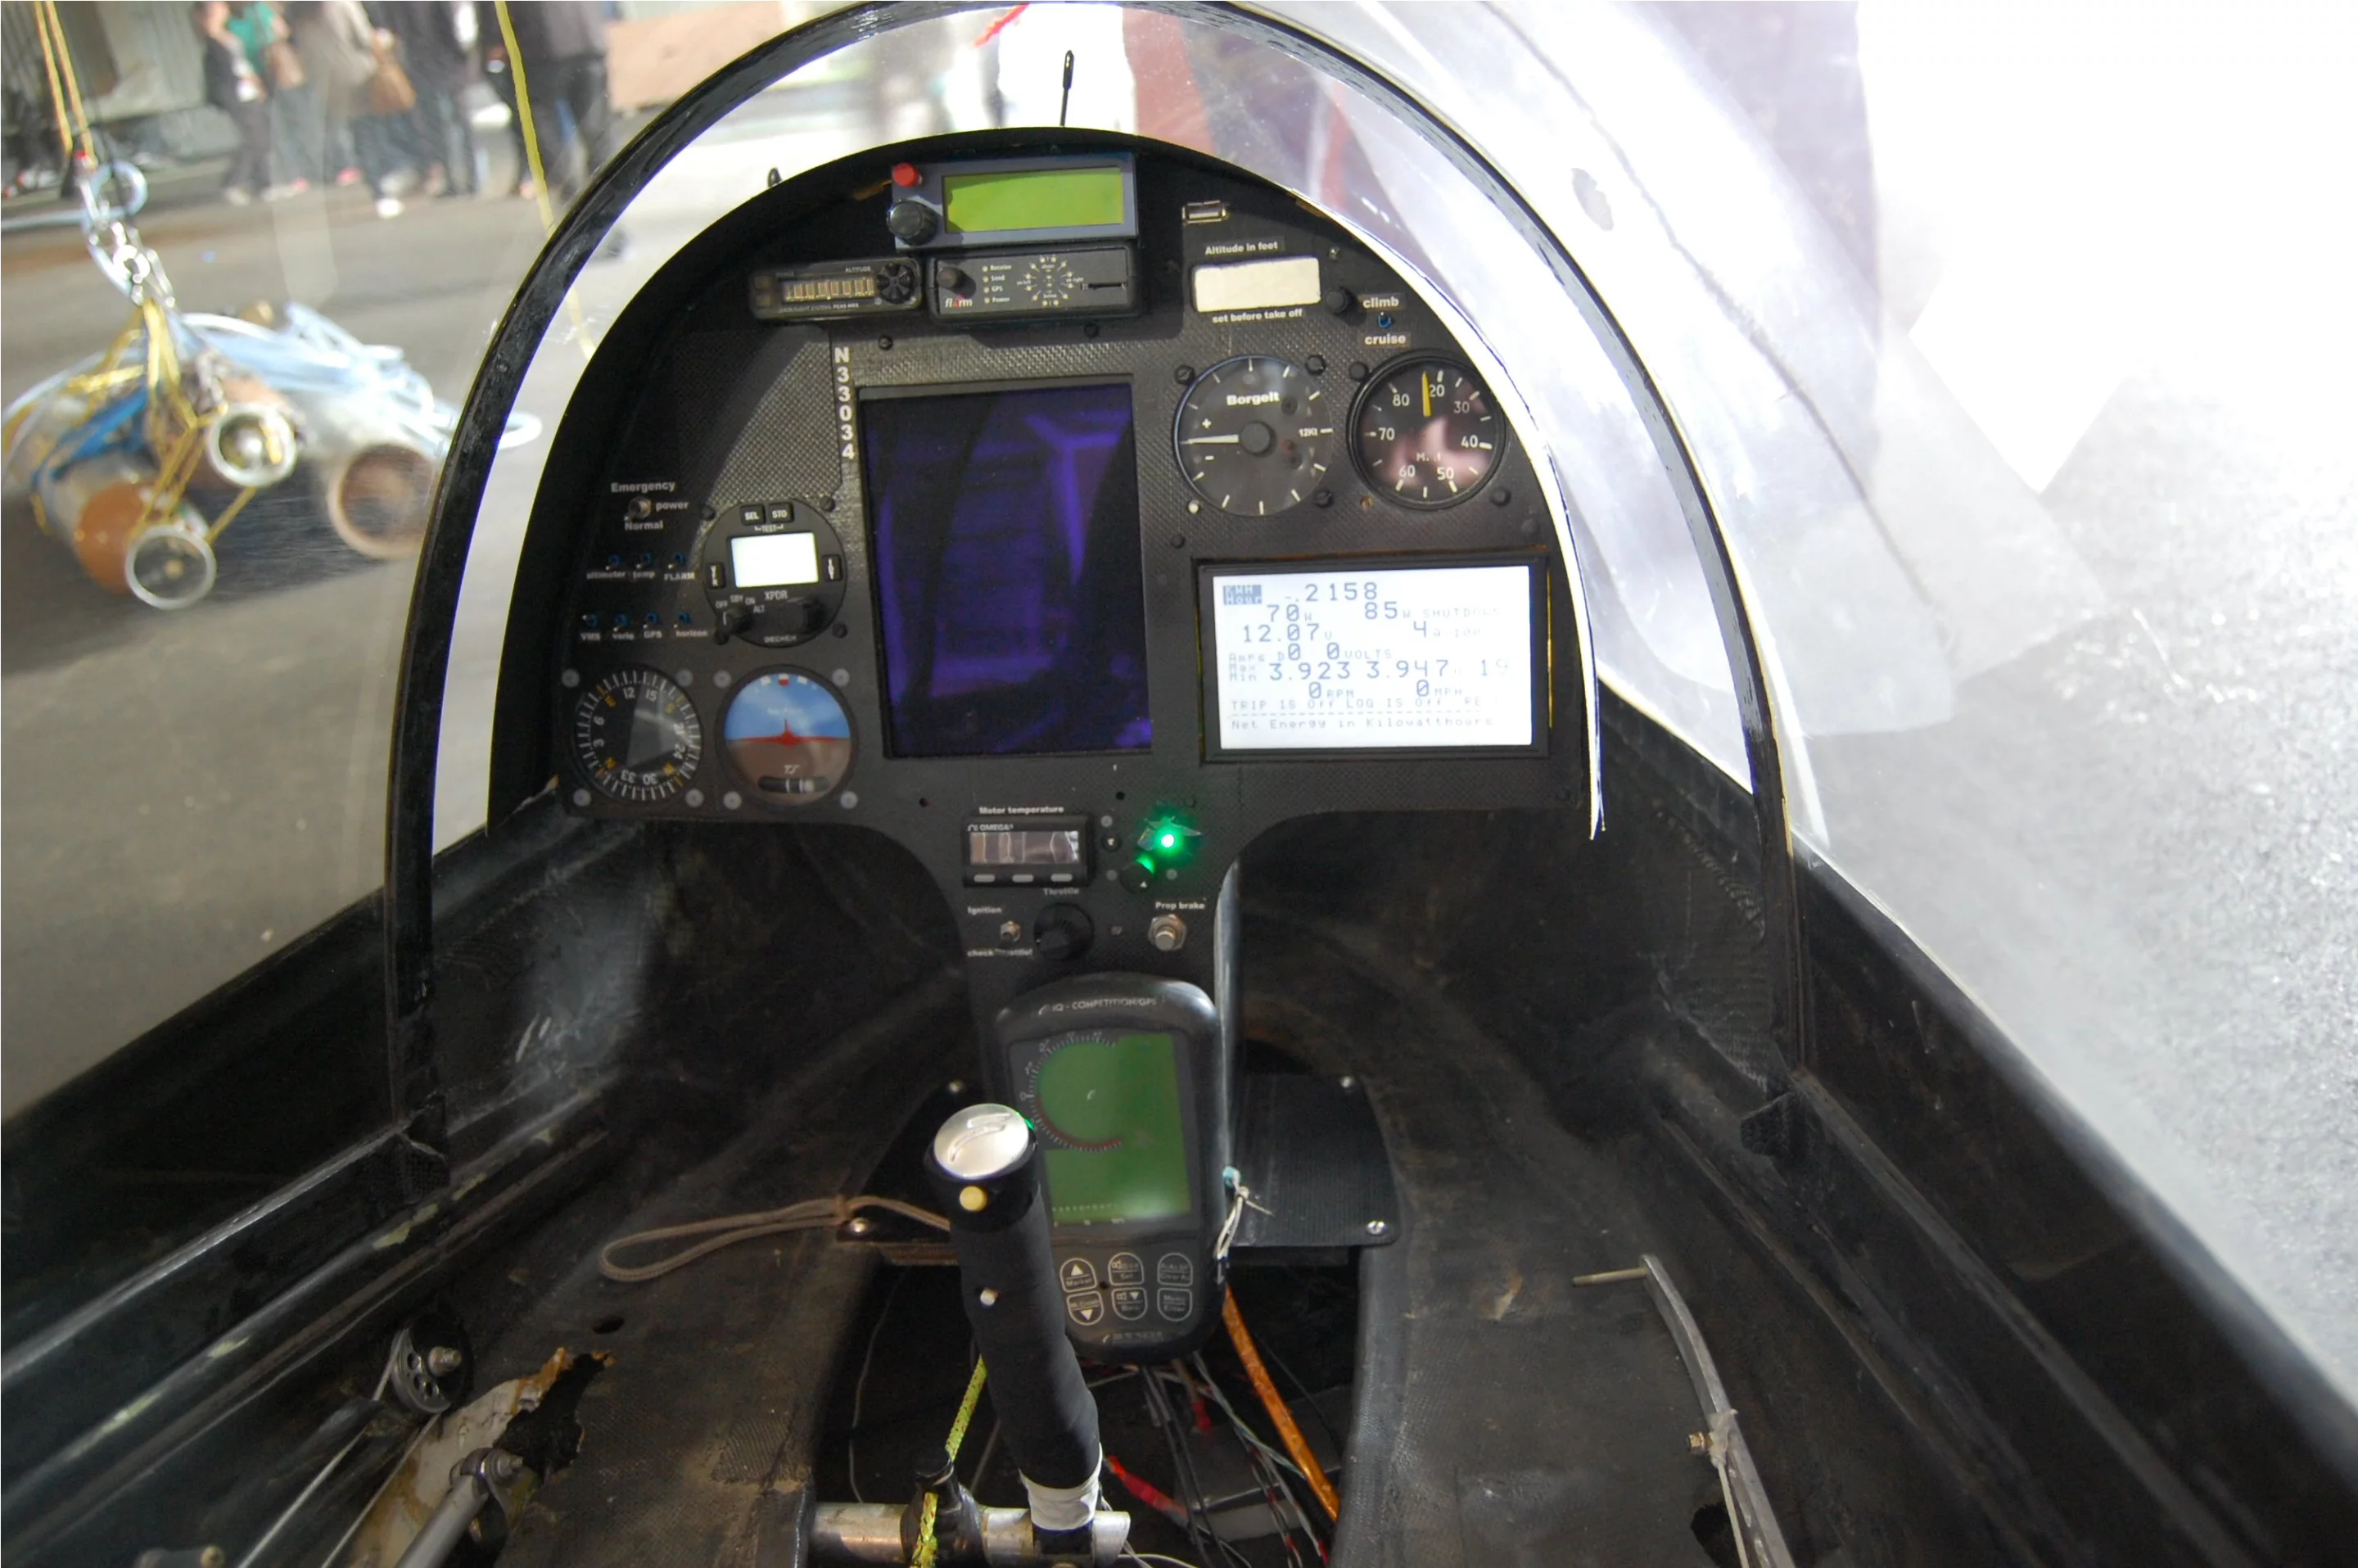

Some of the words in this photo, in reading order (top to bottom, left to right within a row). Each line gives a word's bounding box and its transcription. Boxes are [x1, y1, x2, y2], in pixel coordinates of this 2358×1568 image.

[1204, 242, 1244, 255] Altitude
[1245, 242, 1255, 252] in
[1258, 241, 1279, 251] feet
[992, 296, 1010, 304] Power
[1362, 296, 1399, 309] climb
[1212, 314, 1228, 323] set
[1230, 311, 1263, 322] before
[1264, 310, 1285, 320] take
[1286, 309, 1303, 319] off
[1364, 334, 1407, 345] cruise
[1429, 385, 1446, 398] 20
[834, 346, 855, 459] N33034
[1226, 391, 1280, 406] Borgelt
[1393, 394, 1411, 408] 80
[1454, 401, 1470, 414] 30
[1378, 427, 1396, 441] 70
[1461, 435, 1479, 449] 40
[1398, 464, 1416, 478] 60
[1436, 466, 1455, 481] 50
[611, 481, 676, 493] Emergency
[656, 501, 689, 511] power
[744, 511, 760, 521] SEL
[772, 509, 788, 518] STO
[625, 521, 664, 531] Normal
[632, 571, 655, 580] temp
[664, 572, 695, 581] FLARM
[745, 597, 756, 605] ON
[764, 590, 788, 601] XPDR
[716, 599, 729, 608] OFF
[753, 604, 765, 613] ALT
[612, 632, 635, 640] vario
[644, 630, 662, 639] GPS
[675, 630, 708, 638] horizon
[1229, 663, 1256, 672] Max
[1269, 662, 1351, 680] 3.923
[1366, 659, 1449, 679] 3.947
[1229, 672, 1257, 683] Min
[622, 687, 635, 699] 12
[645, 689, 657, 702] 15
[1434, 686, 1463, 697] MPH
[1232, 701, 1268, 712] TRIP
[1281, 700, 1296, 710] IS
[1308, 698, 1335, 710] Off
[1387, 698, 1403, 708] IS
[1416, 697, 1441, 707] Off
[594, 716, 605, 726] 6
[1232, 719, 1258, 730] Net
[1270, 718, 1326, 730] Energy
[1339, 718, 1355, 729] in
[1366, 716, 1493, 728] Kilowatthours
[593, 739, 605, 748] 3
[674, 743, 685, 759] 24
[621, 770, 637, 784] 33
[643, 773, 658, 785] 30
[1008, 806, 1064, 815] temperature
[967, 906, 1002, 915] Ignition
[1155, 901, 1177, 911] Prop
[1179, 901, 1205, 910] brake
